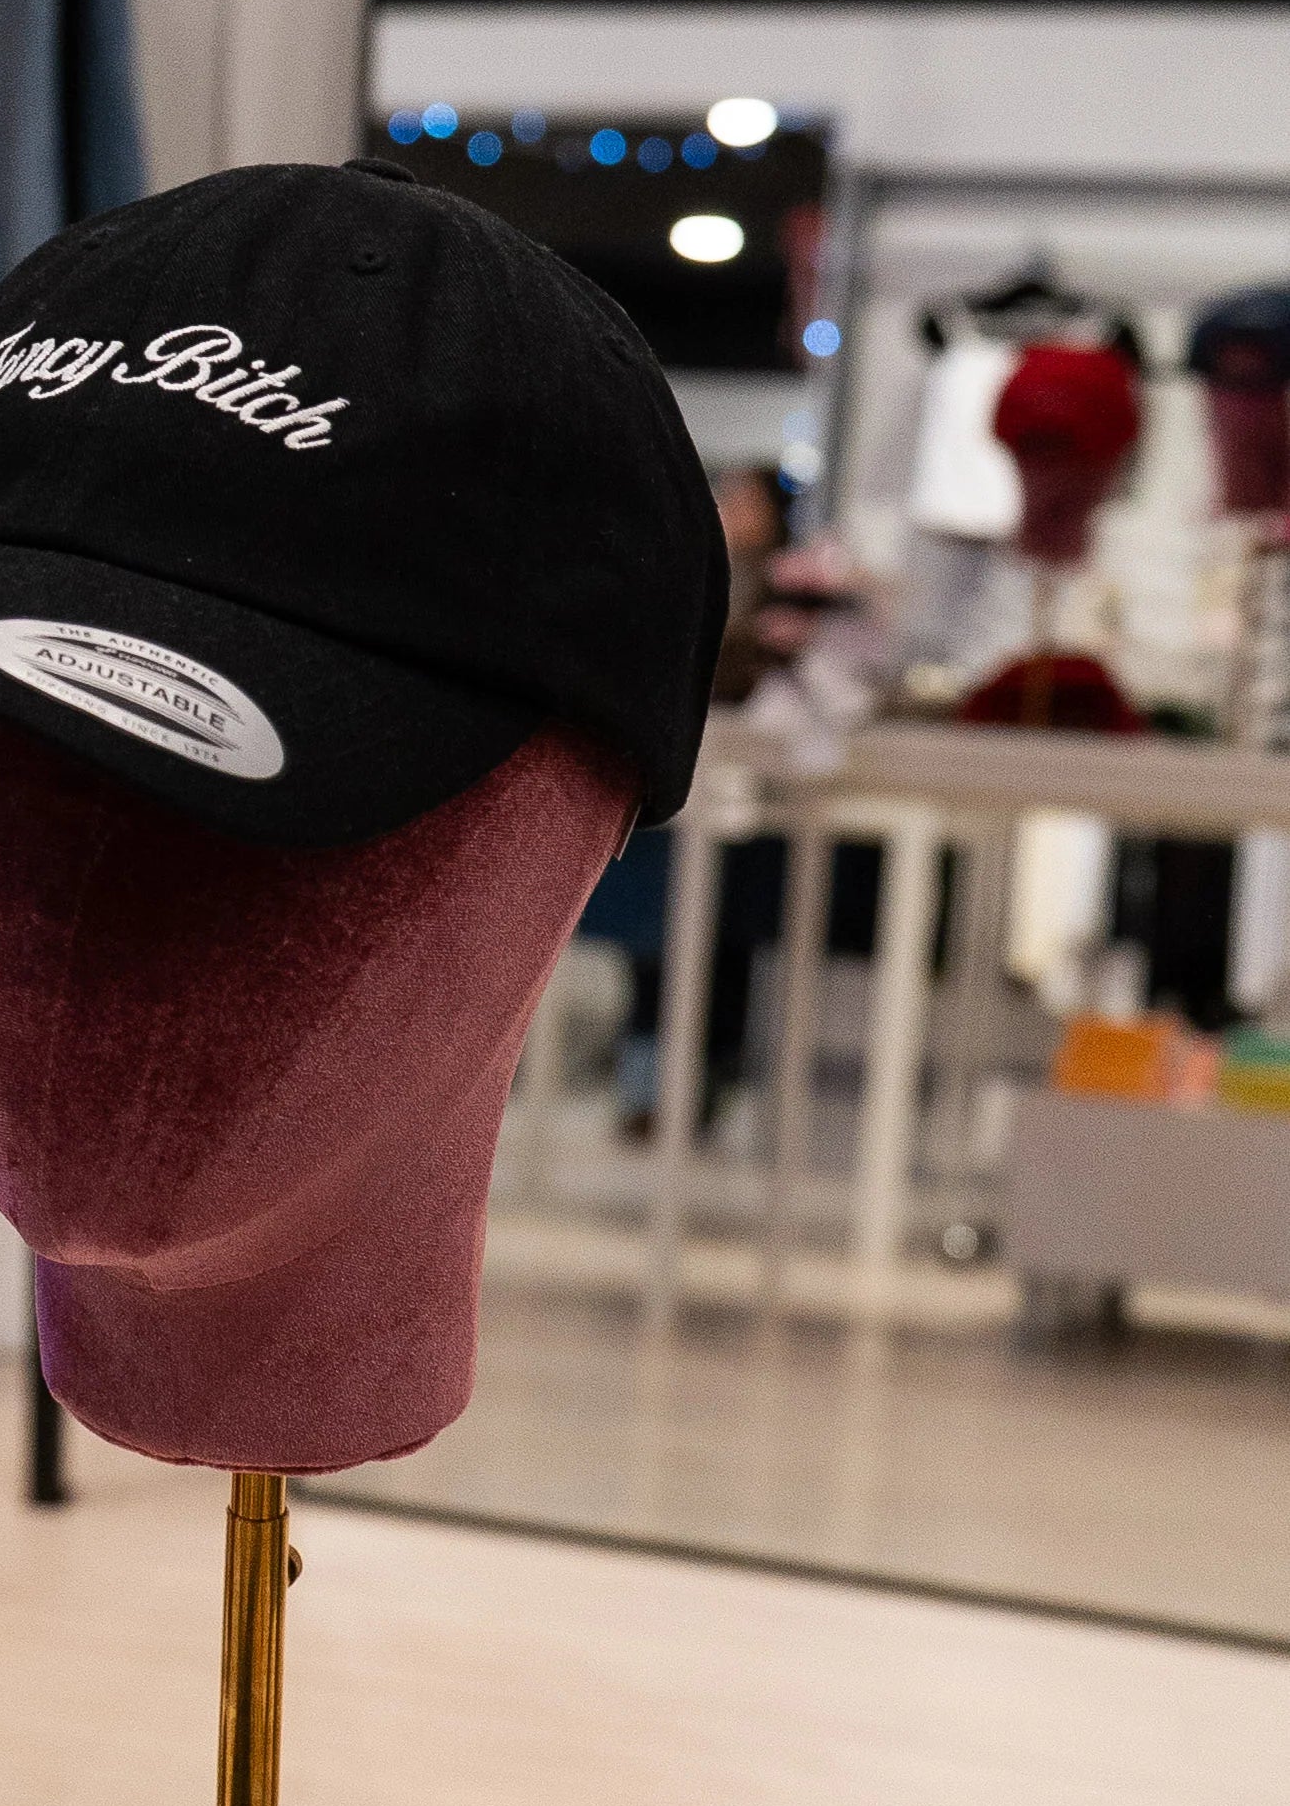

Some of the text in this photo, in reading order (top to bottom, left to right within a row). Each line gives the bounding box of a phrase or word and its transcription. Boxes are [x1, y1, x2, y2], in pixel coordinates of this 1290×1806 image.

[111, 323, 351, 451] Bitch
[35, 647, 226, 733] ADJUSTABLE
[108, 636, 219, 688] AUTHENTIC
